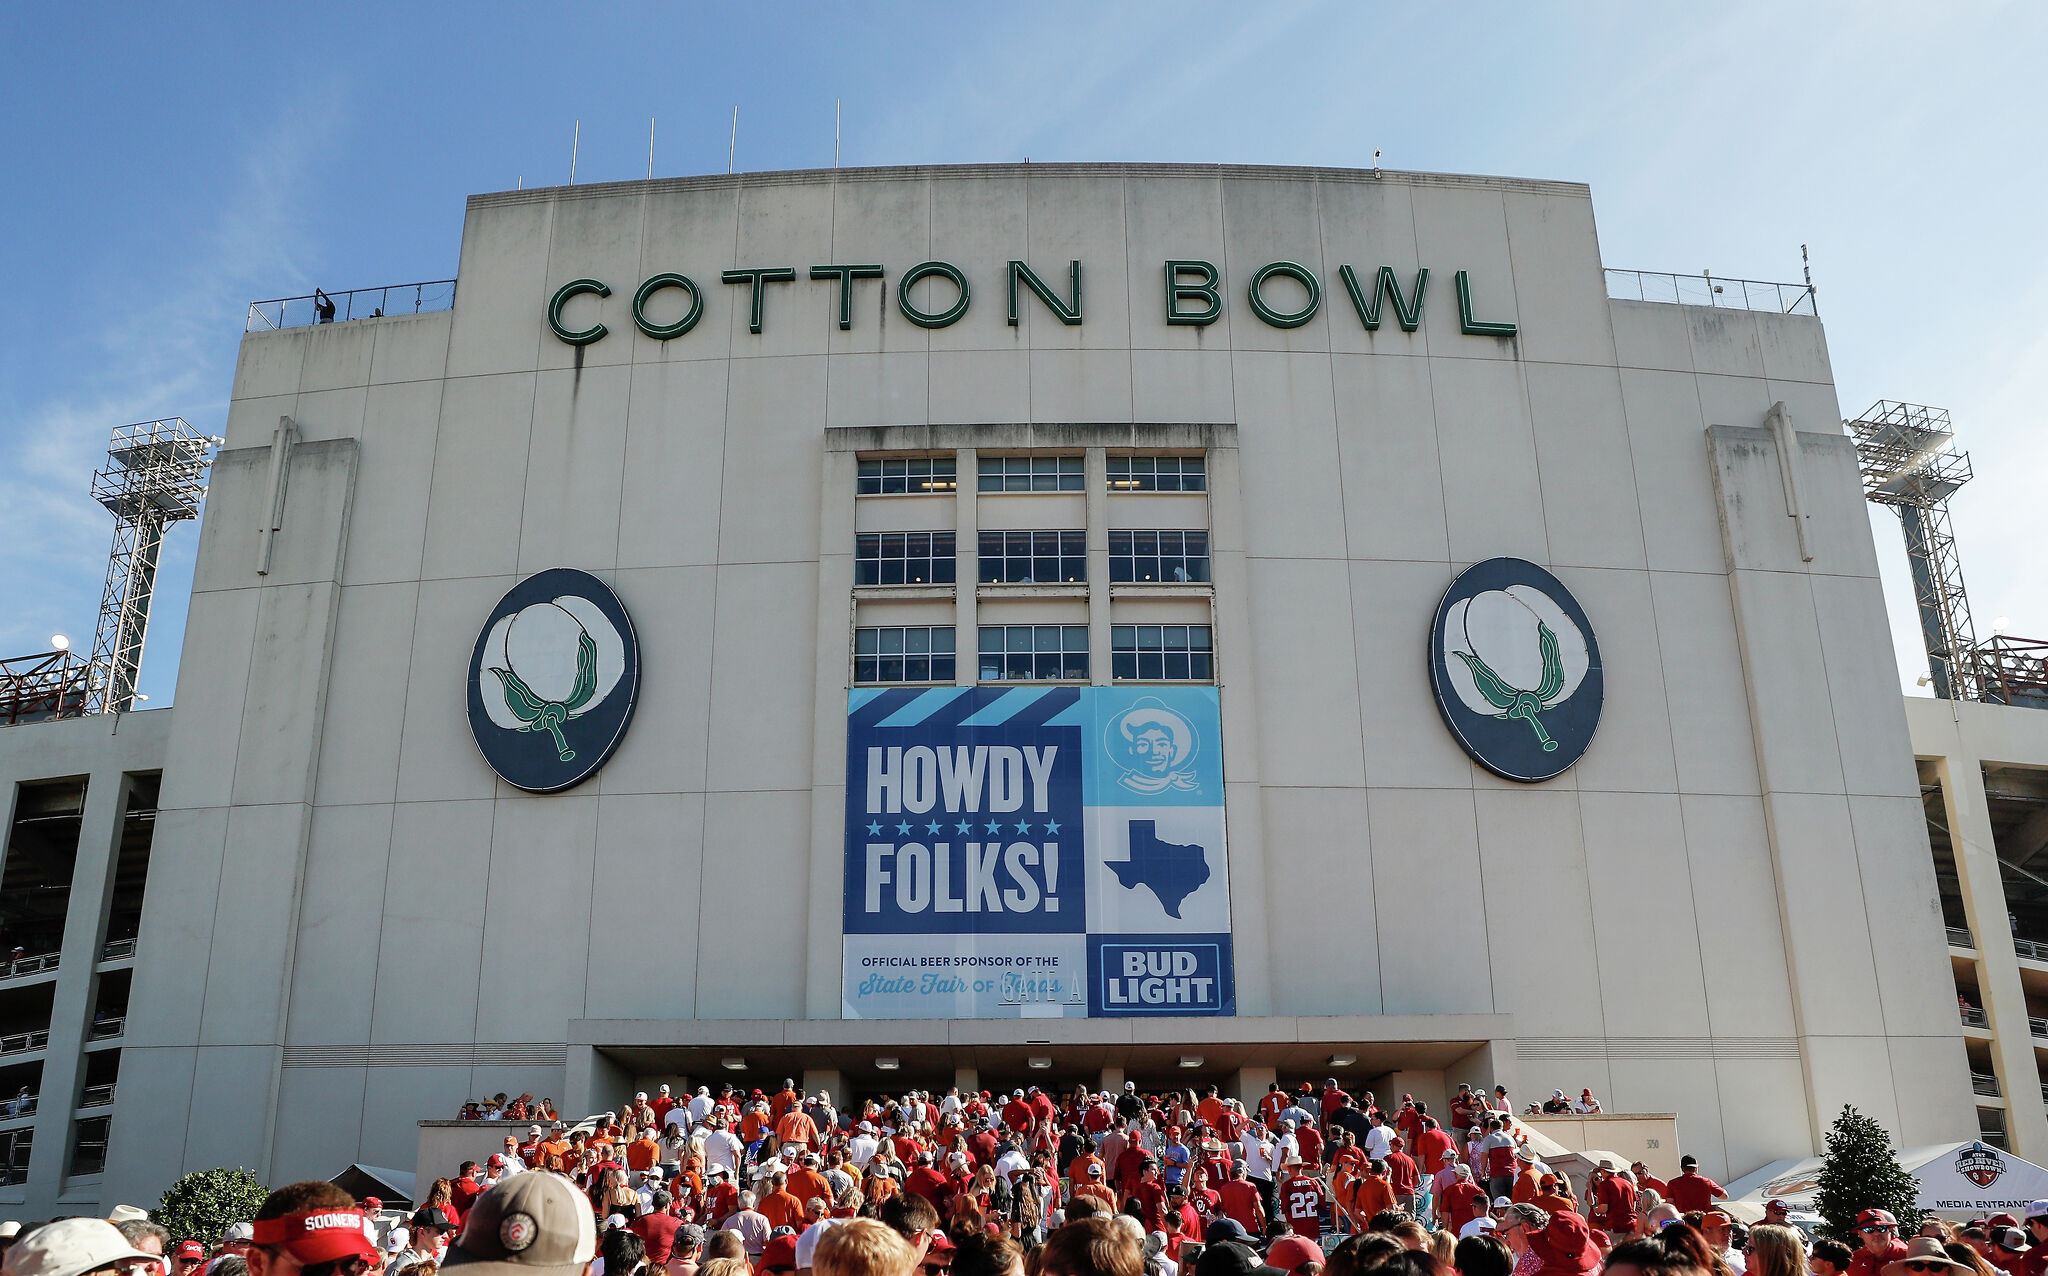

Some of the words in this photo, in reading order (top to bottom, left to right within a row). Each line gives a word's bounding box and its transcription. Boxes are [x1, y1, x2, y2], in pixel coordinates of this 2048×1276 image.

[547, 259, 1083, 346] COTTON
[1164, 259, 1518, 337] BOWL
[866, 745, 1059, 815] HOWDY
[865, 841, 1060, 914] FOLKS!
[861, 957, 917, 967] OFFICIAL
[920, 957, 951, 967] BEER
[953, 957, 1012, 967] SPONSOR
[1015, 957, 1032, 967] OF
[1035, 957, 1059, 967] THE
[1122, 951, 1198, 977] BUD
[858, 972, 916, 998] State
[920, 973, 969, 995] Fair
[973, 980, 994, 993] OF
[1002, 970, 1056, 1003] GATE
[1069, 969, 1081, 1002] A
[1108, 977, 1213, 1004] LIGHT
[1956, 1158, 1974, 1170] RED
[1974, 1157, 2006, 1170] RIVER
[1960, 1164, 2002, 1173] SHOWDOWN
[1290, 1191, 1318, 1219] 22
[1936, 1200, 1973, 1208] MEDIA
[1976, 1200, 2035, 1208] ENTRANC
[304, 1212, 361, 1231] SOONERS
